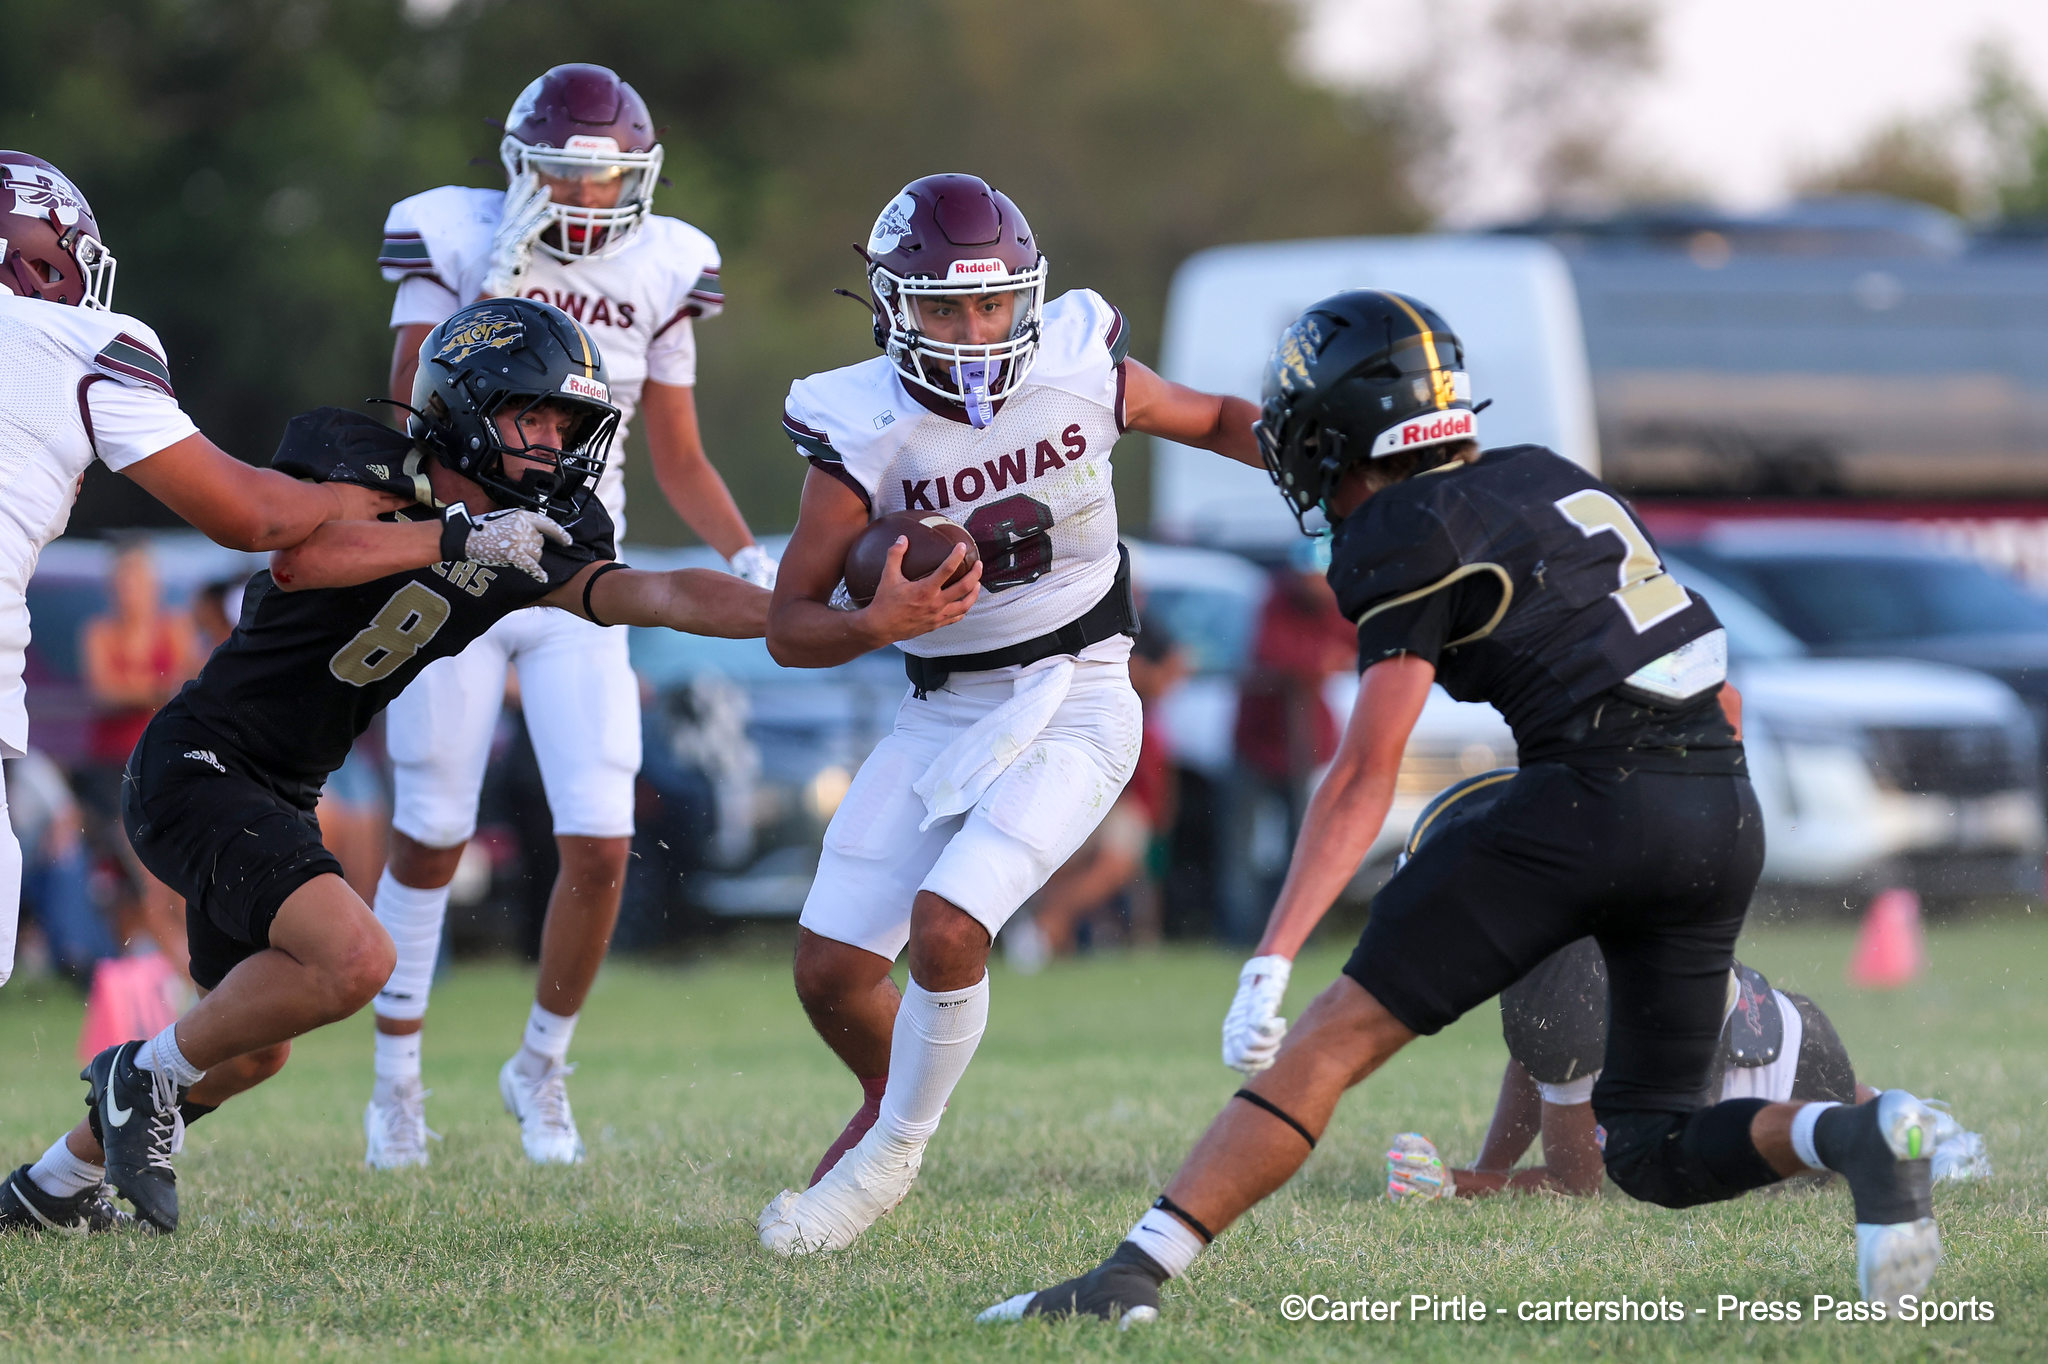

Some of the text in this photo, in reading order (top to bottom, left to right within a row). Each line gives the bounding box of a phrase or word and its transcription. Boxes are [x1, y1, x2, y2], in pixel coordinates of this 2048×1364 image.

[955, 261, 1001, 274] Riddell
[516, 286, 636, 329] OWAS
[570, 379, 608, 401] Riddell
[902, 423, 1087, 511] KIOWAS
[1553, 488, 1693, 635] 2
[329, 579, 451, 687] 8
[183, 752, 226, 773] adidas
